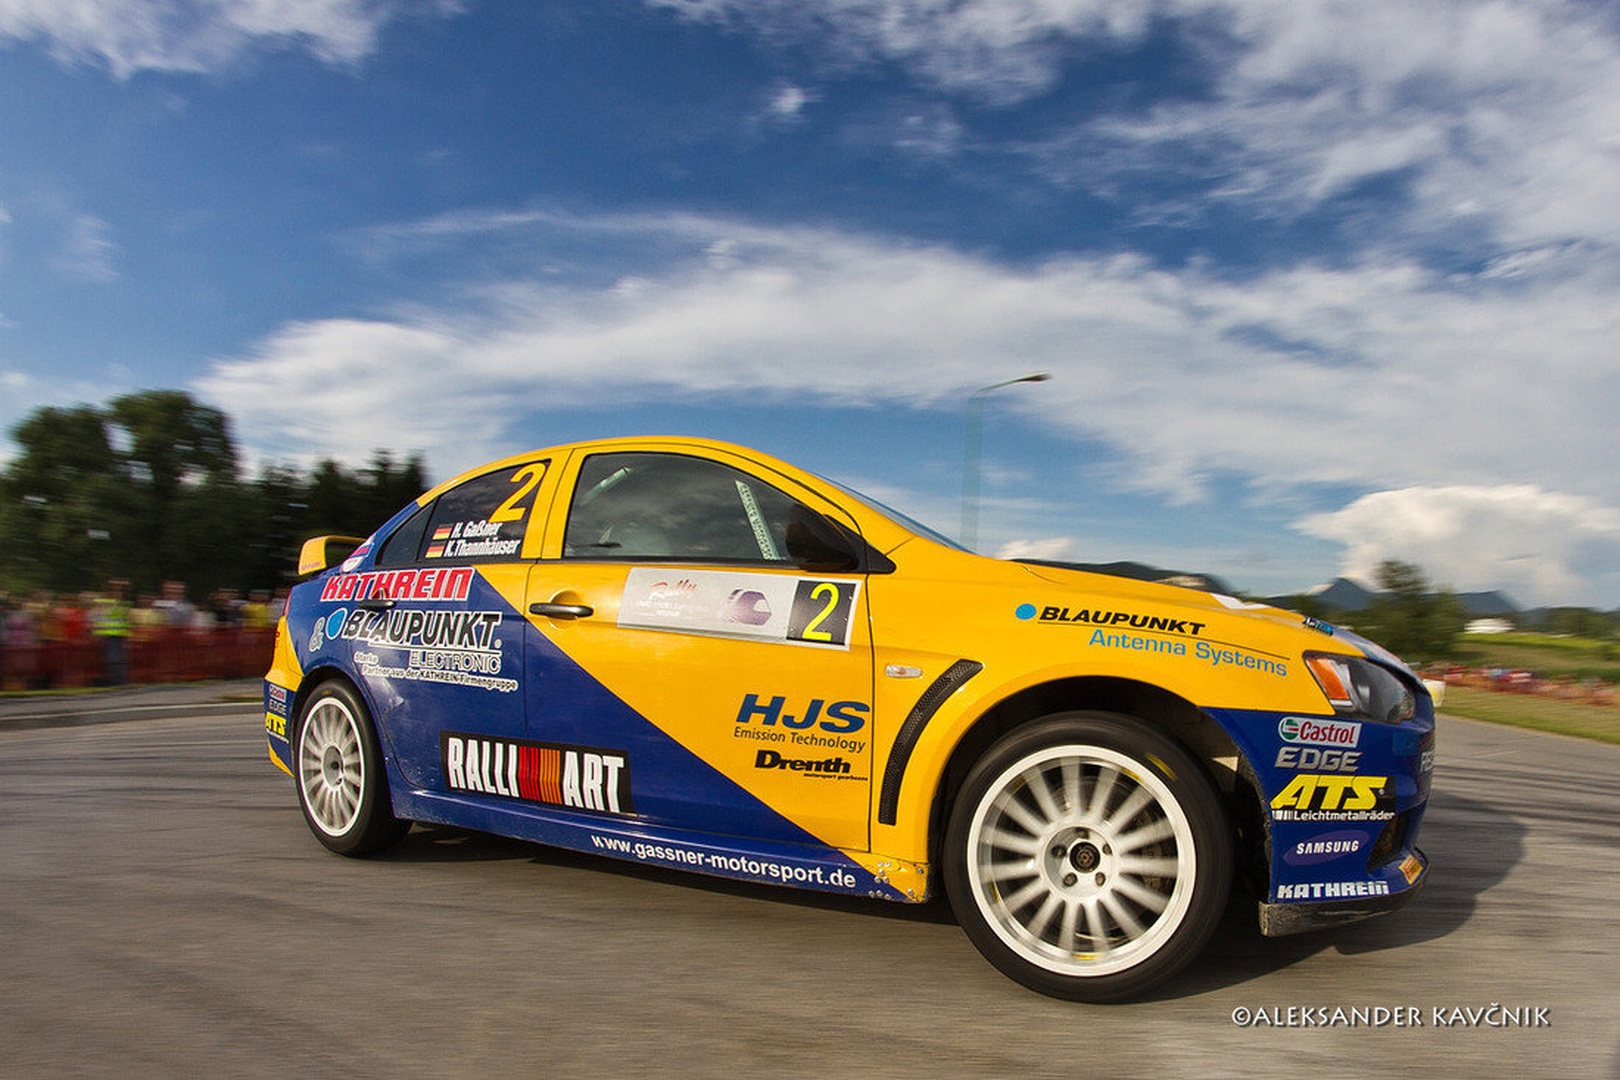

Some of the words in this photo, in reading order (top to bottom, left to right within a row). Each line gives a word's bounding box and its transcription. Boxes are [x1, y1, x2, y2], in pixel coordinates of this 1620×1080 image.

[488, 462, 546, 524] 2
[320, 567, 476, 602] KATHREIN
[802, 582, 840, 641] 2
[1040, 605, 1206, 637] BLAUPUNKT
[410, 650, 502, 675] ELECTRONIC
[1089, 629, 1186, 658] Antenna
[1195, 641, 1287, 678] Systems
[405, 667, 420, 680] der
[736, 694, 870, 734] HJS
[735, 725, 785, 743] Emission
[790, 731, 866, 754] Technology
[1299, 721, 1356, 745] Castrol
[755, 749, 851, 773] Drenth
[1274, 746, 1363, 772] EDGE
[1269, 774, 1388, 810] ATS
[1294, 809, 1396, 821] Leichtmetallräder
[591, 834, 857, 888] www.gassner-motorsport.de
[1296, 840, 1360, 855] SAMSUNG
[1276, 881, 1390, 899] KATHREIN
